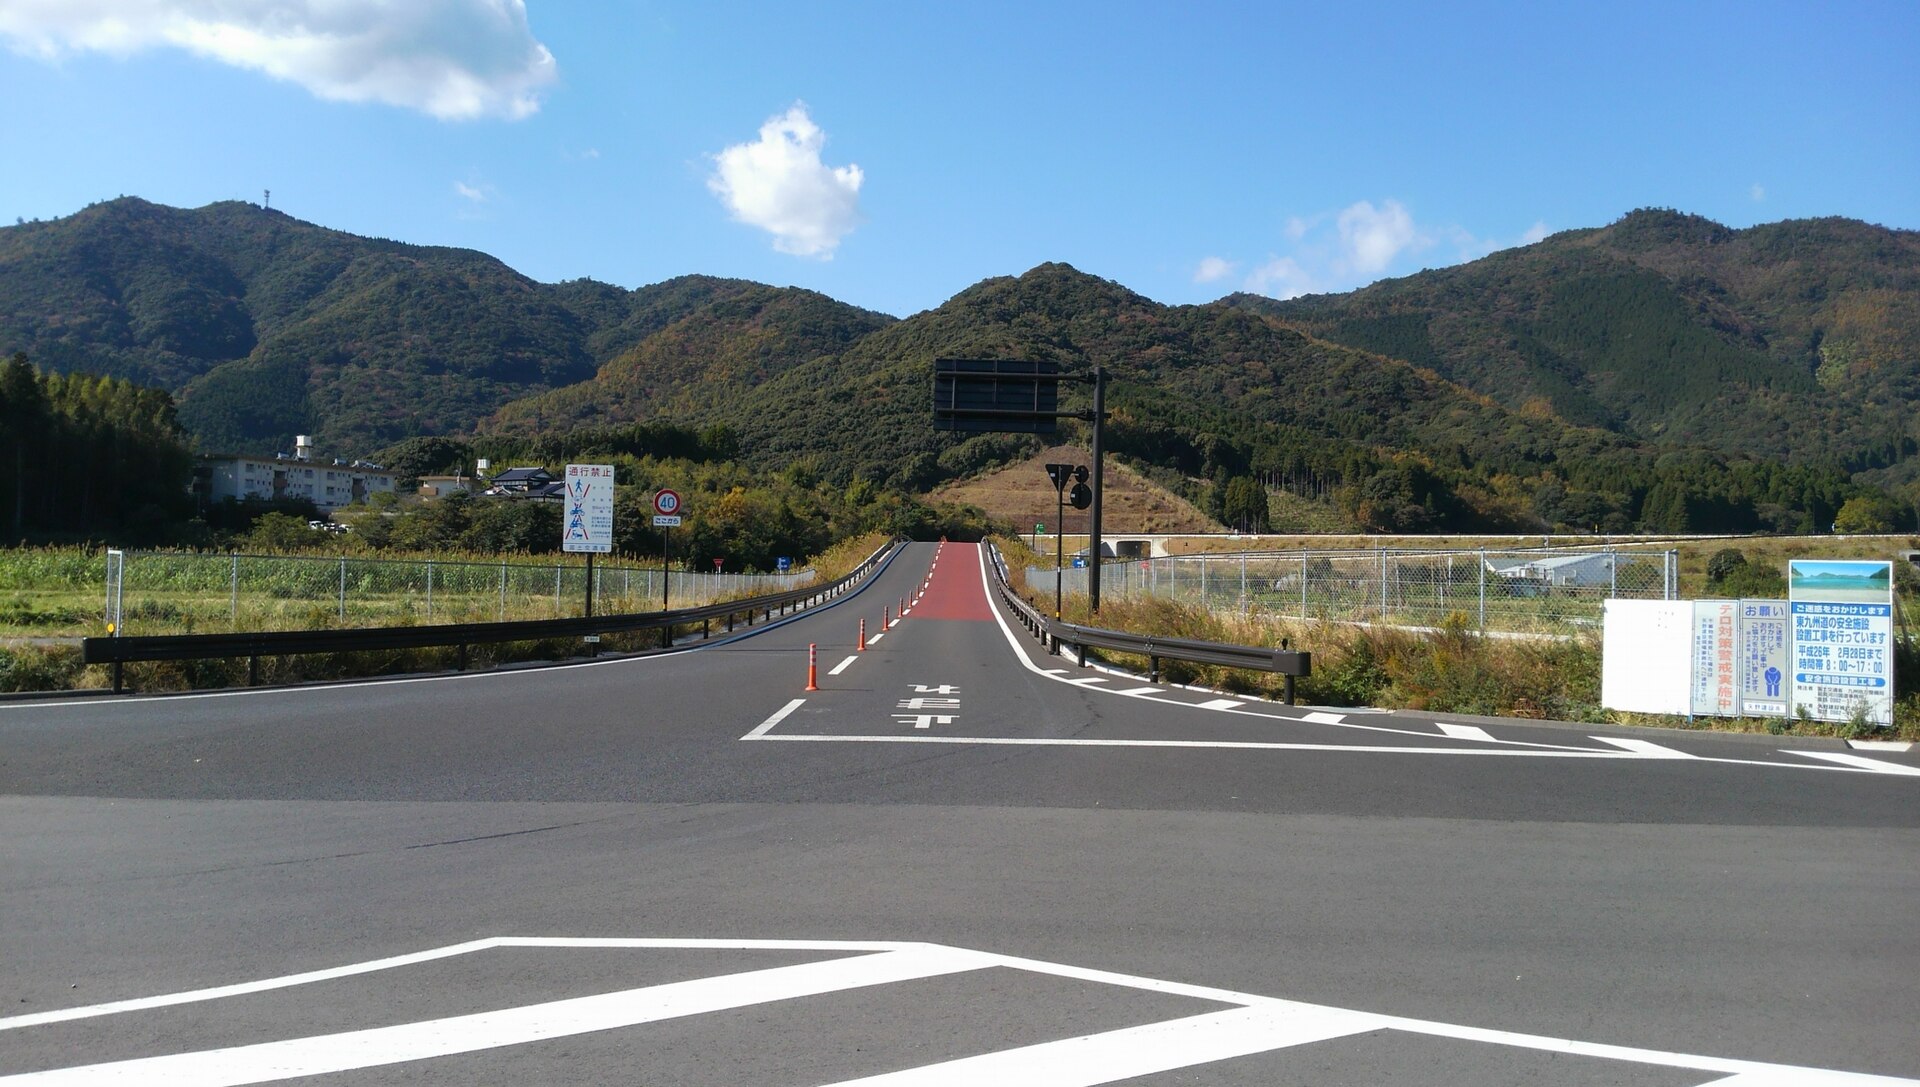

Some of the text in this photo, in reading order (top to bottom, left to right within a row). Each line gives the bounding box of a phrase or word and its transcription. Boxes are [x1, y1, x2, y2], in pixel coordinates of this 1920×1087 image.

[569, 467, 611, 477] 通行禁止
[660, 497, 675, 509] 40
[655, 517, 679, 525] ここから
[1745, 606, 1784, 617] お願い
[1796, 604, 1886, 615] ご迷惑をおかけします
[1796, 616, 1870, 630] 東九州道の安全施設
[1796, 629, 1886, 644] 設置工事を行っています
[1718, 604, 1733, 709] テロ対策警戒実施中
